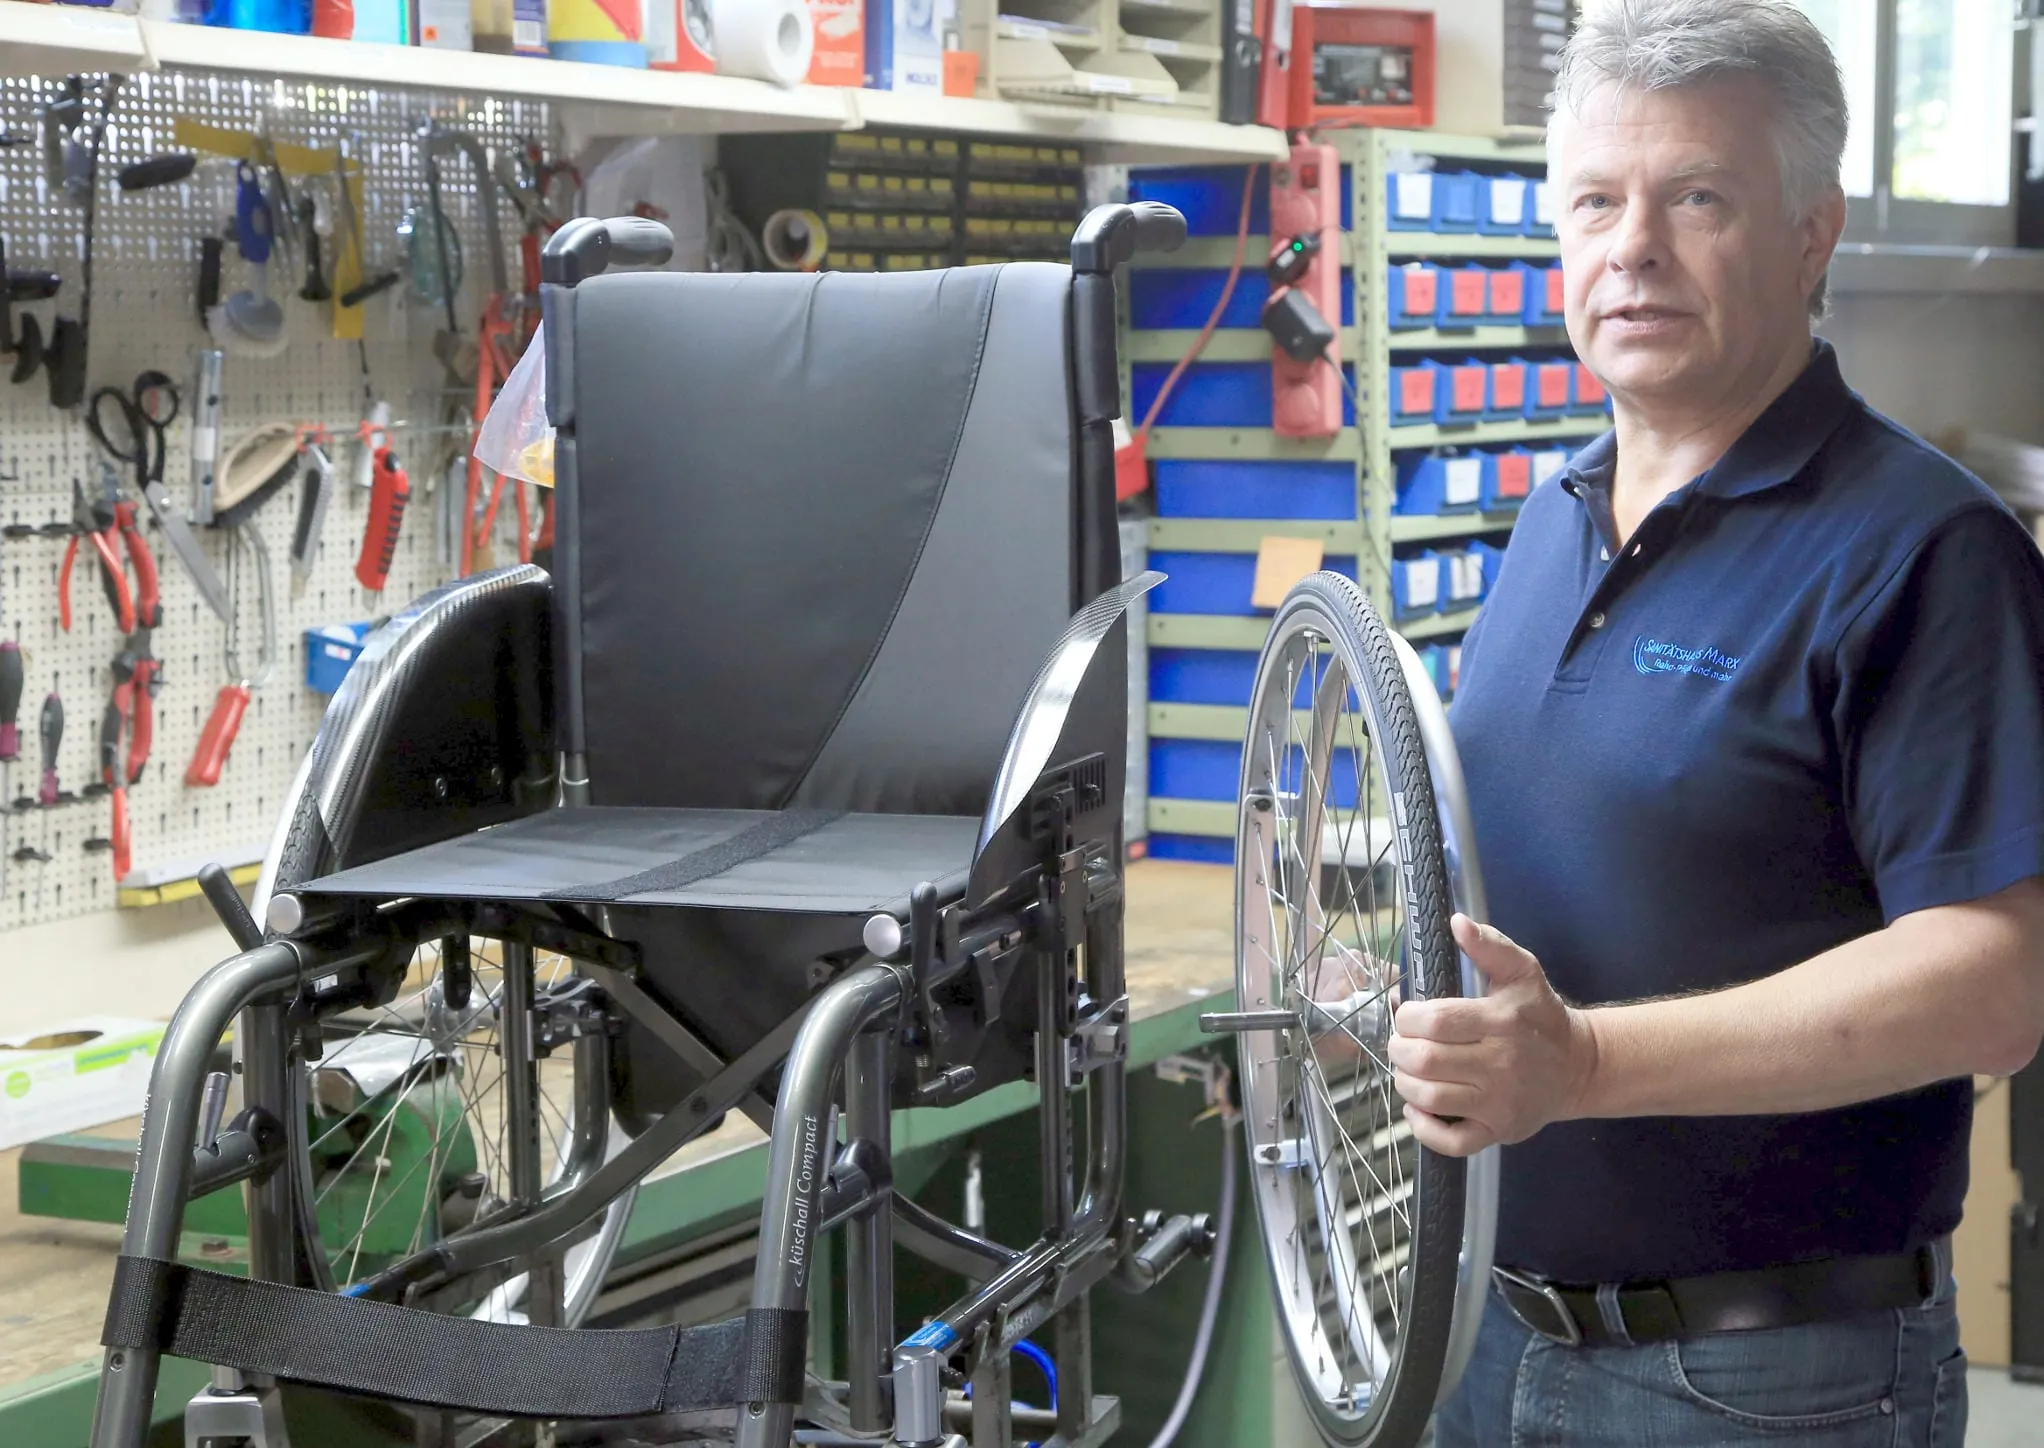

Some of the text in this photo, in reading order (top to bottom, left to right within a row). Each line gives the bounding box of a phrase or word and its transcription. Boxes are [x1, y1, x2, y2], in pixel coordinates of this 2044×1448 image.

[1703, 647, 1741, 670] MARX
[788, 1115, 818, 1266] küschall Compact
